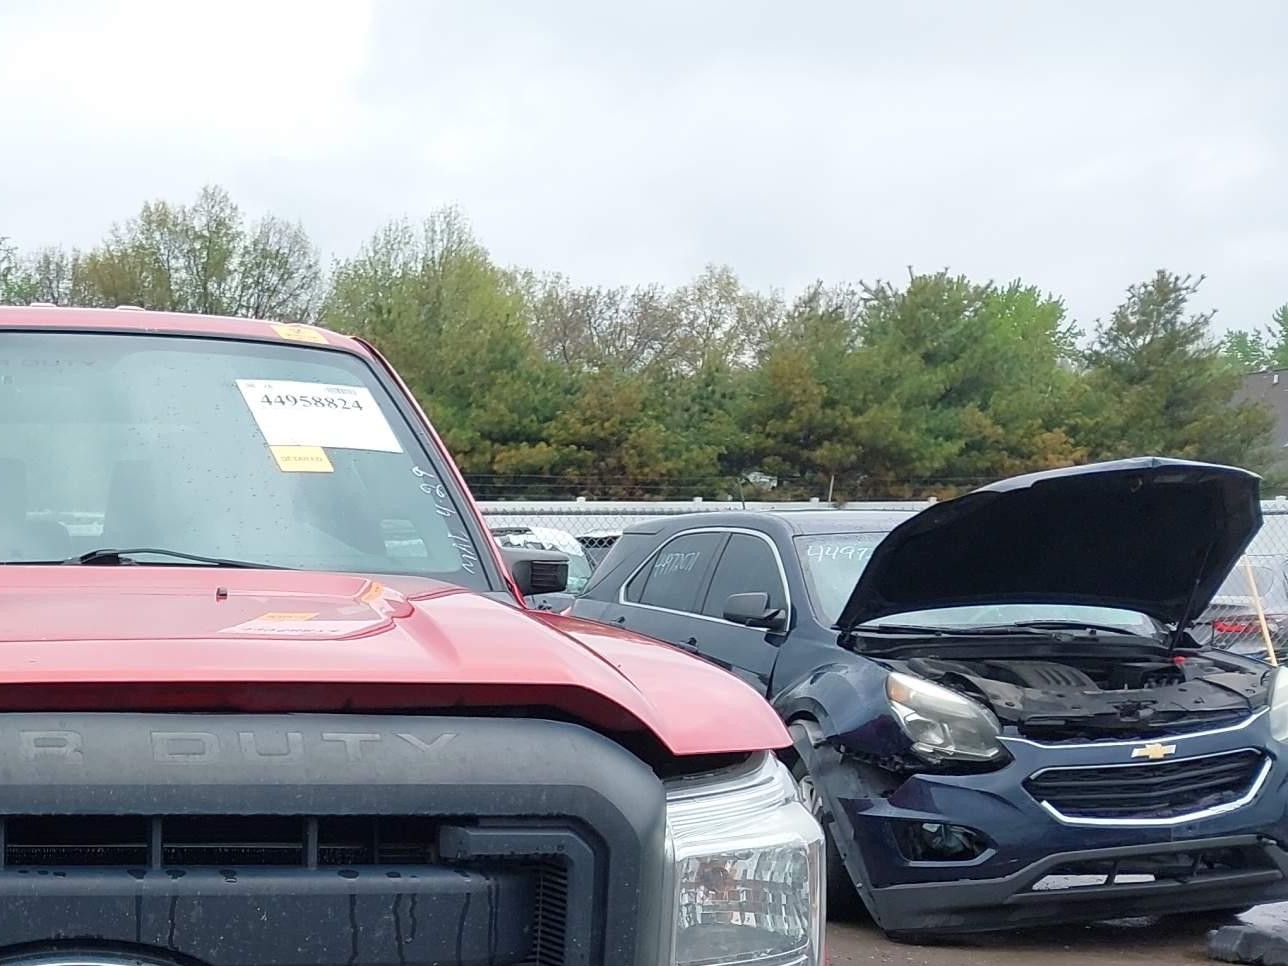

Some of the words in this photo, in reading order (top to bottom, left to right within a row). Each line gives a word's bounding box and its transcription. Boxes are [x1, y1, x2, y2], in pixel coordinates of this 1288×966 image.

[260, 394, 364, 412] 44958824
[807, 544, 872, 562] 4497
[149, 730, 459, 768] DUTY
